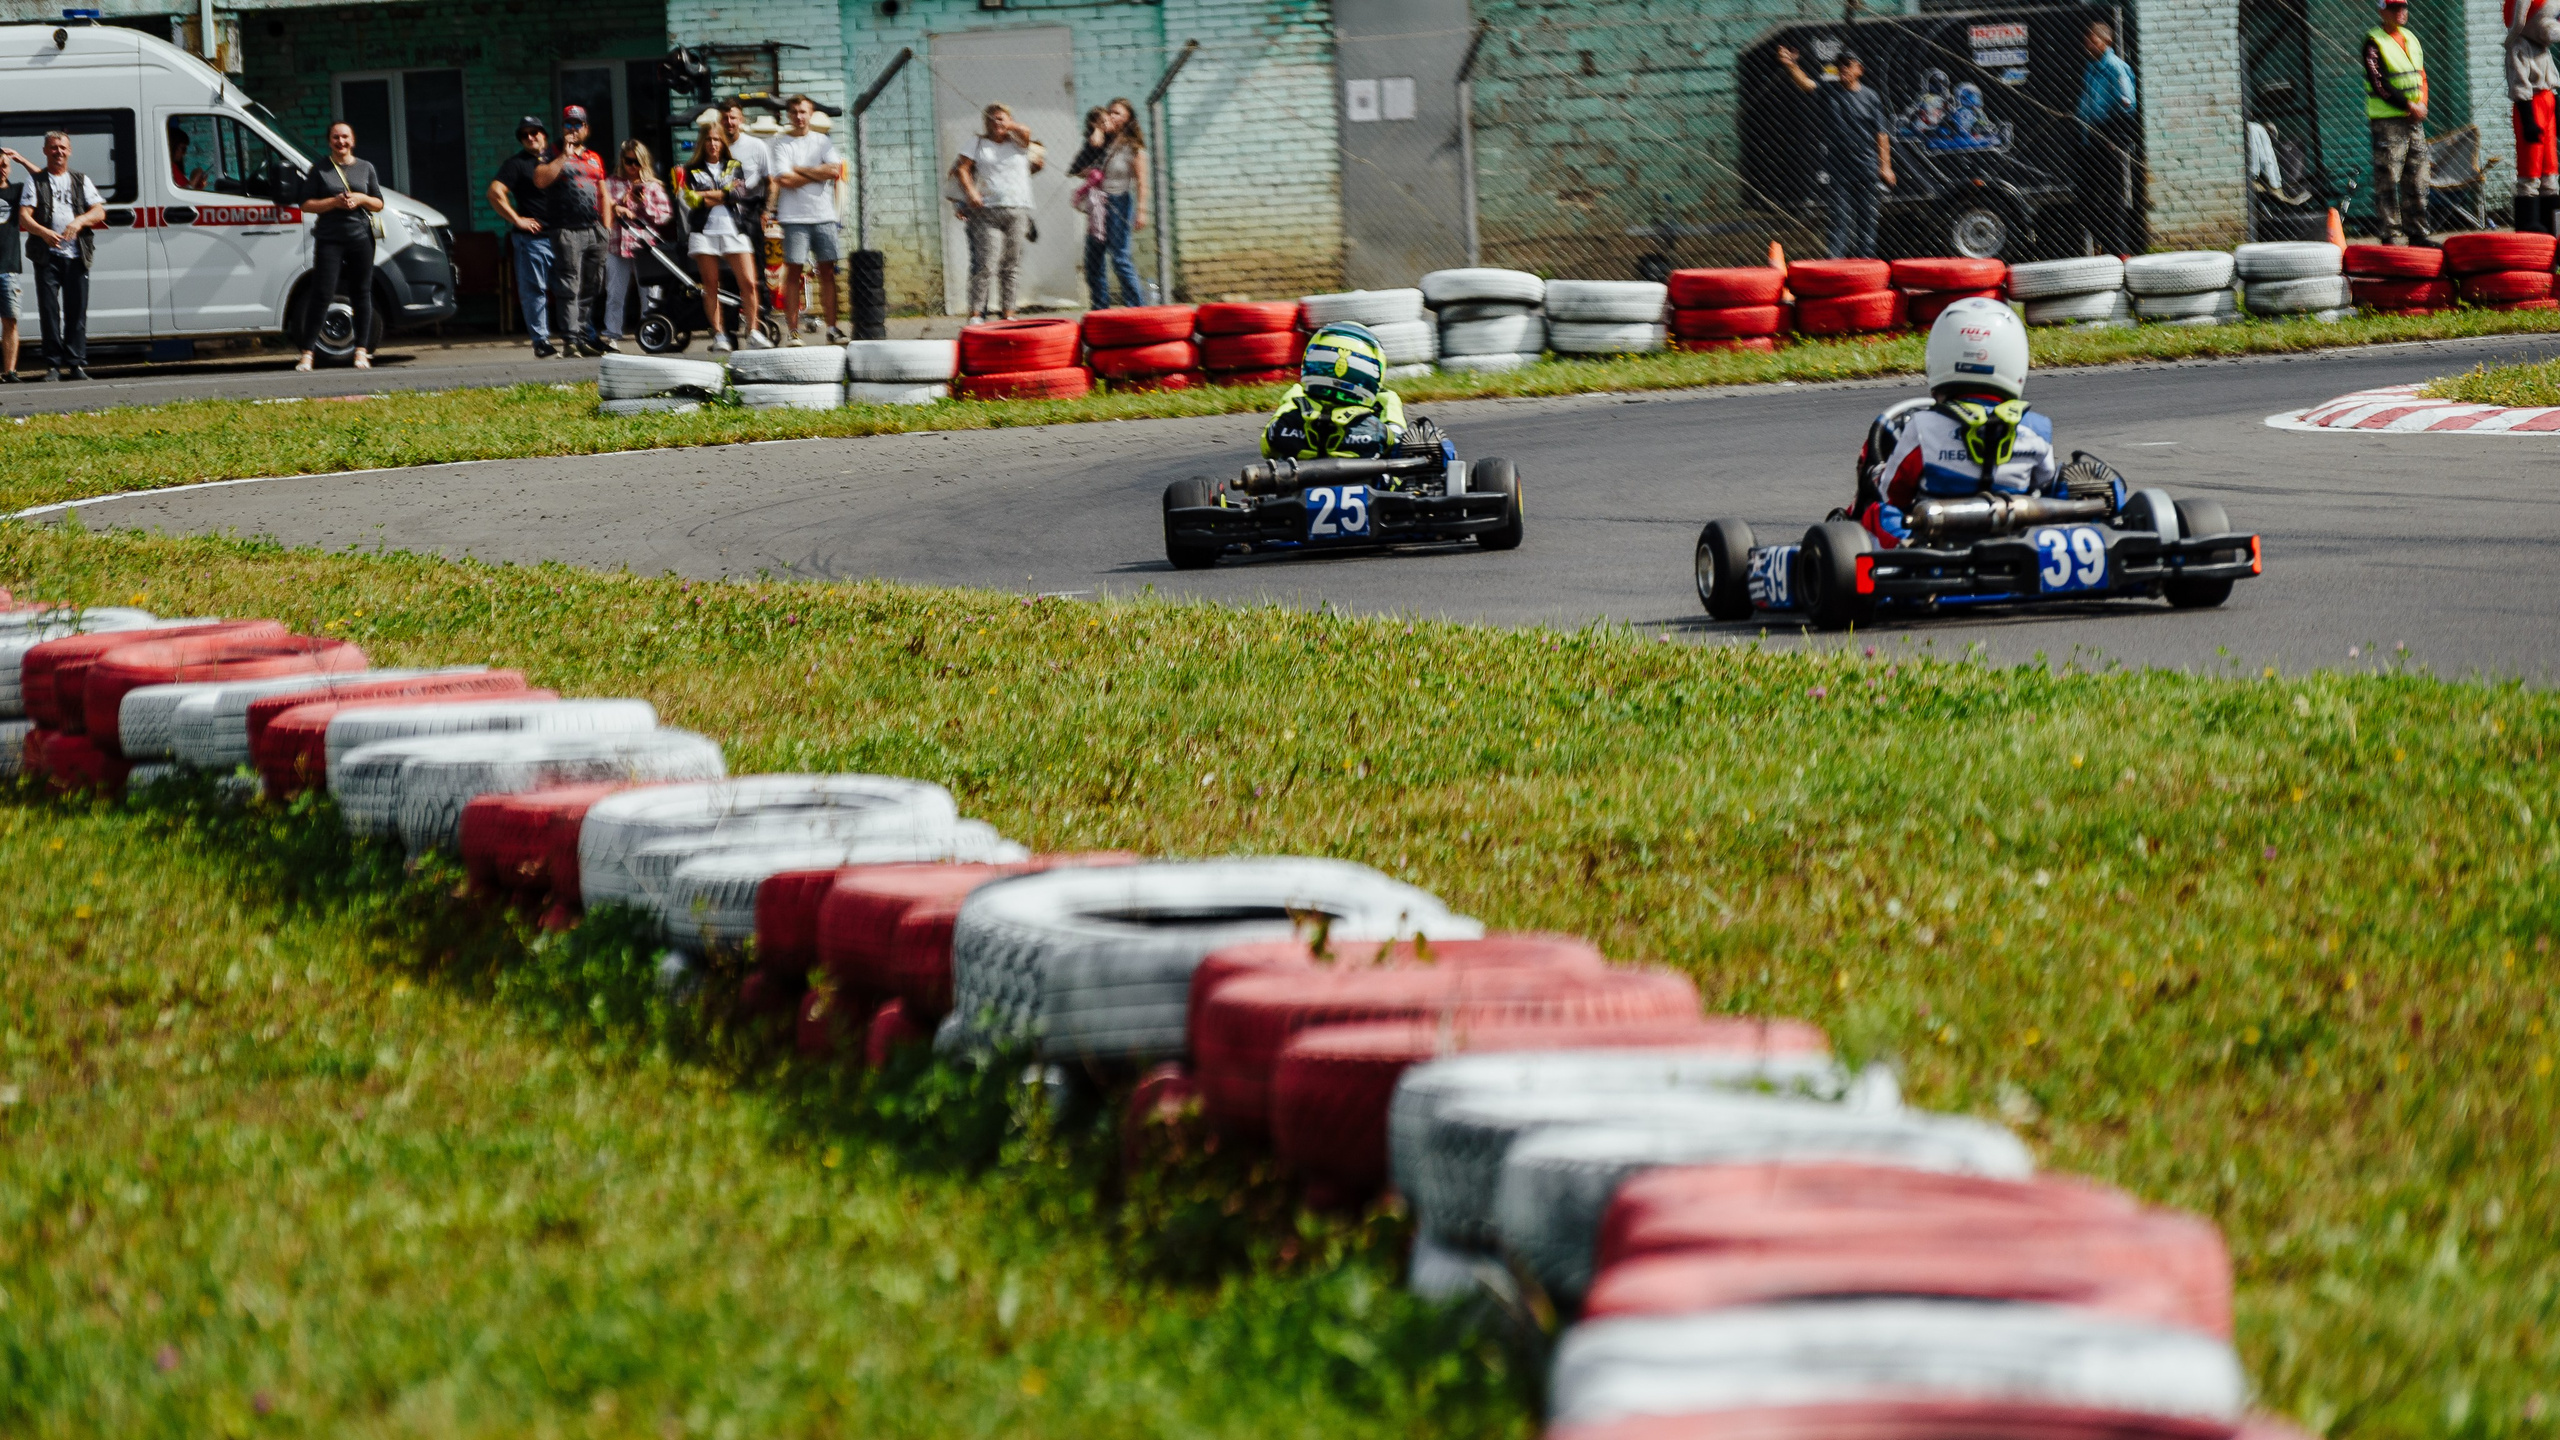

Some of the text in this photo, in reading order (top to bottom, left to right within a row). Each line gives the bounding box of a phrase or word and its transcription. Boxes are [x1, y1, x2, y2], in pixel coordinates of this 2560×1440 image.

[203, 207, 293, 224] ПОМОЩЬ
[1960, 327, 1991, 337] TULA
[1309, 486, 1367, 534] 25
[1766, 546, 1788, 602] 39
[2038, 528, 2106, 587] 39
